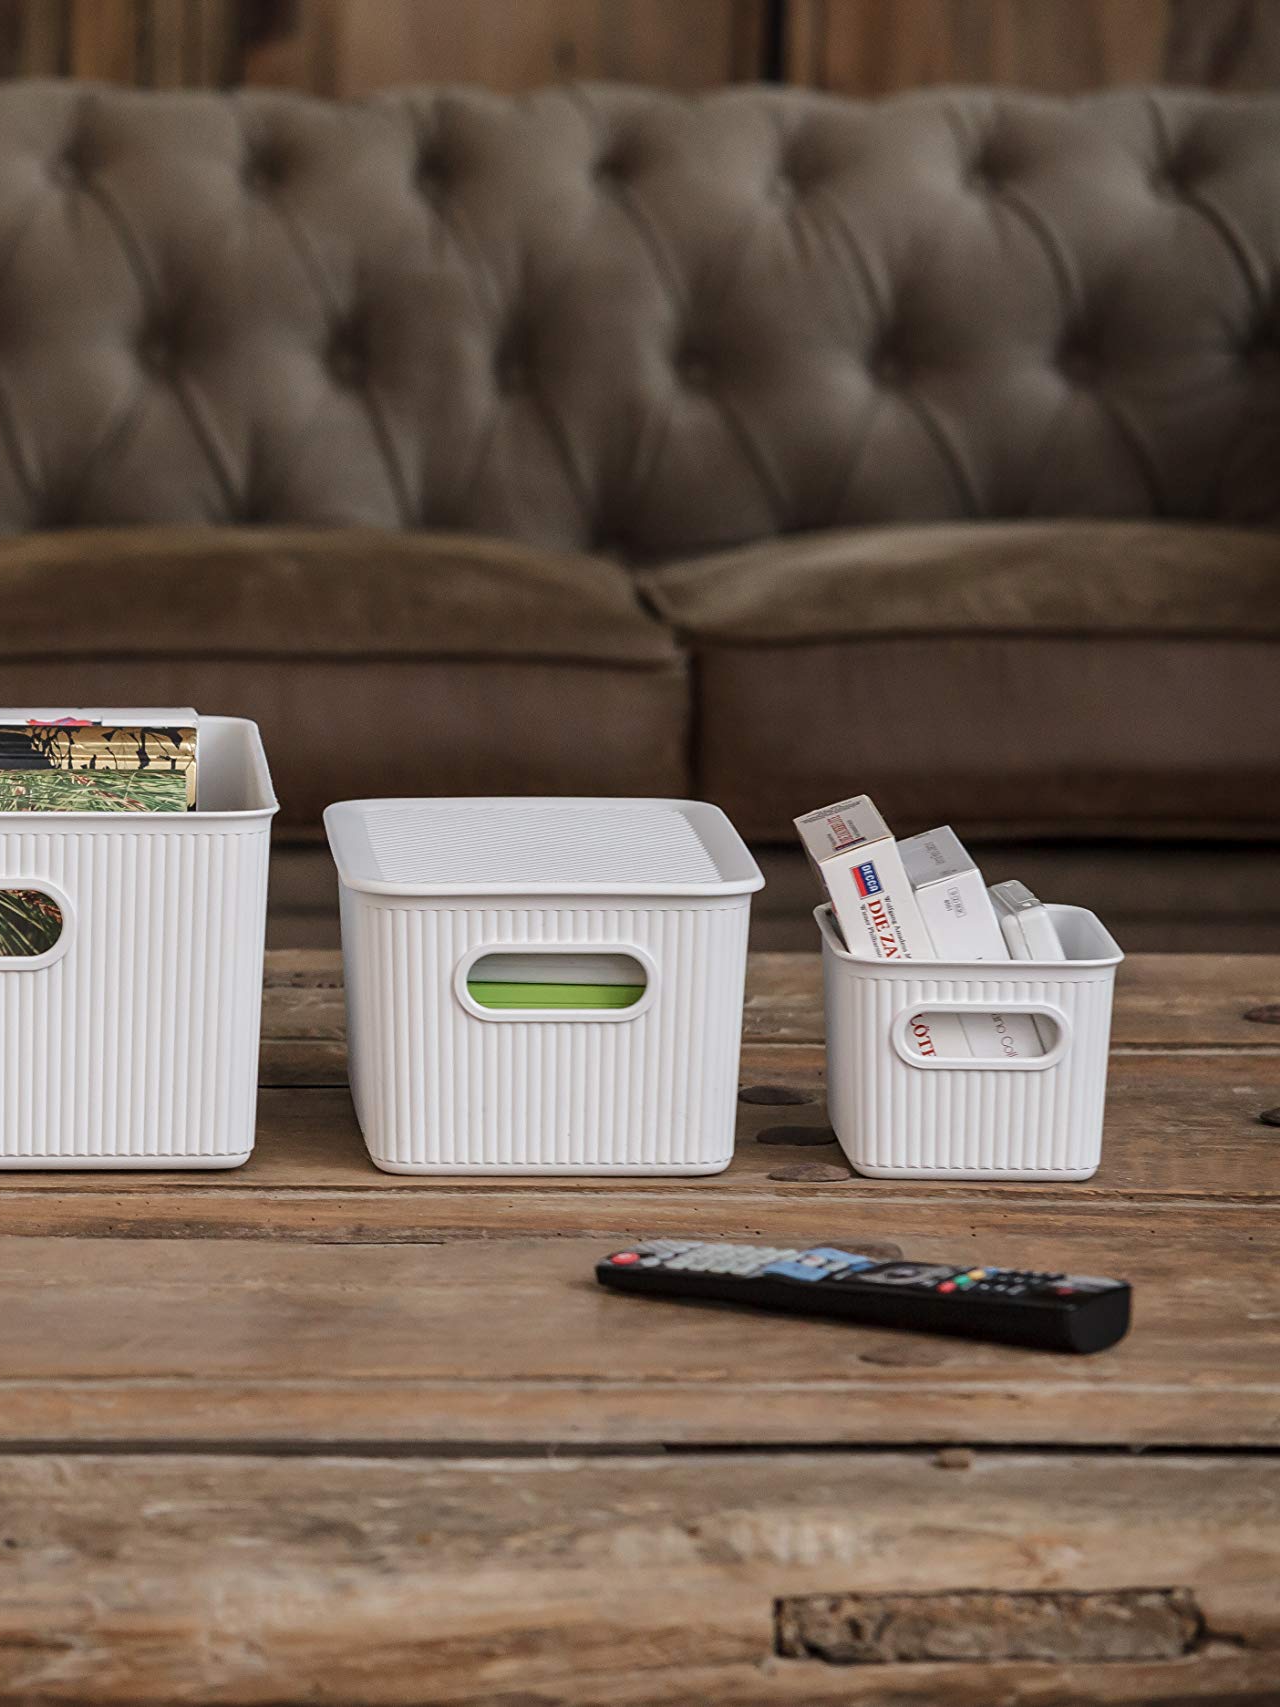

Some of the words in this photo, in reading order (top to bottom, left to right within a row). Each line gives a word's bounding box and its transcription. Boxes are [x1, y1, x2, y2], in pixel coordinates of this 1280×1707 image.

[860, 863, 880, 893] DECCA
[867, 899, 891, 932] DIE
[879, 933, 902, 958] ZA
